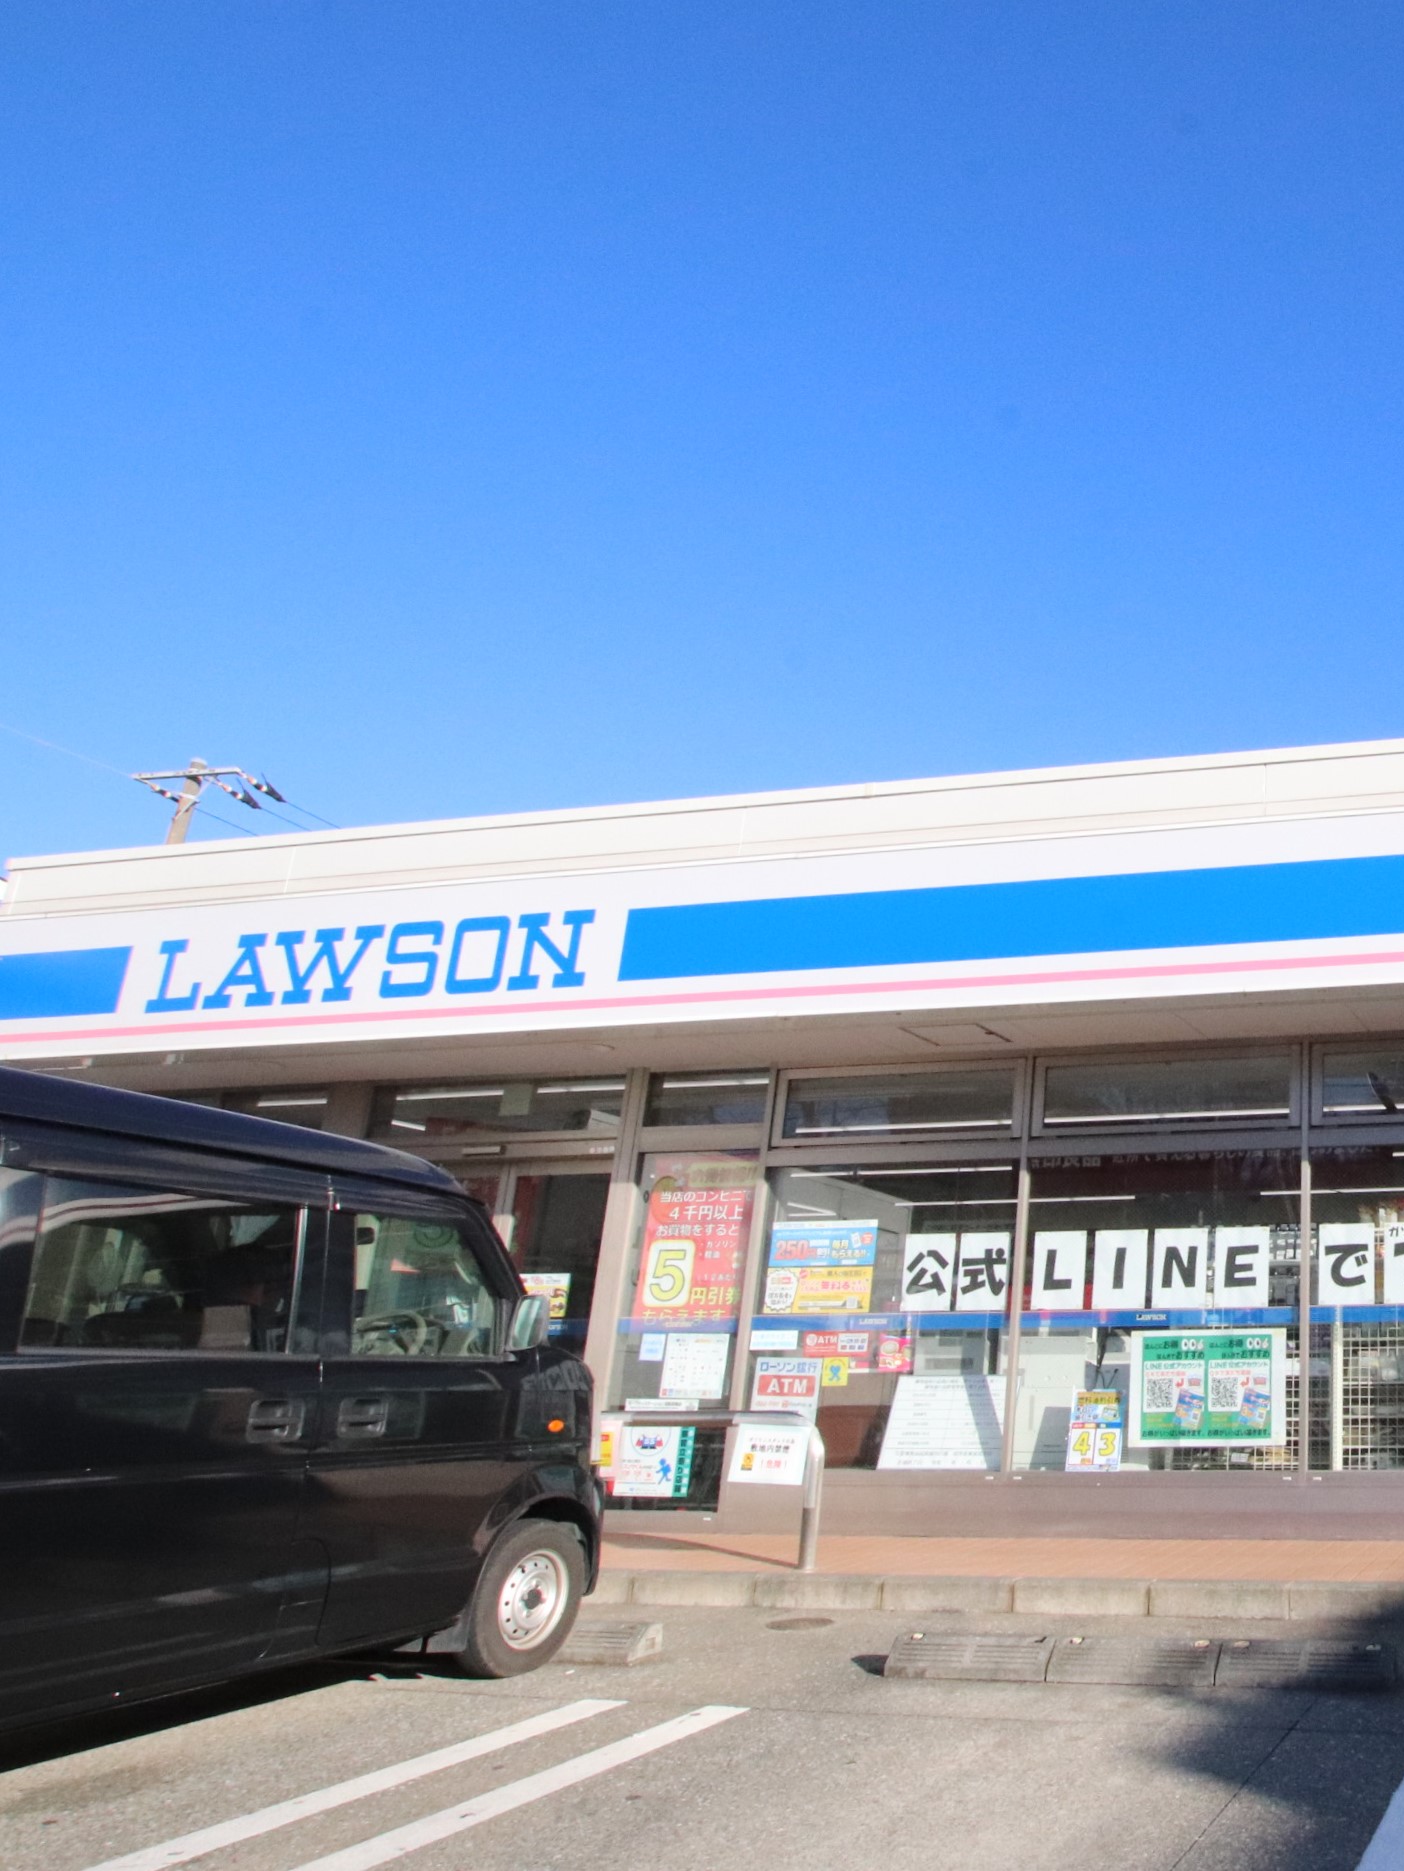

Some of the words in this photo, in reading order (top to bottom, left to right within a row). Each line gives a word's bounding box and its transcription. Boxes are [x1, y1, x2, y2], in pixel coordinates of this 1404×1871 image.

[145, 908, 597, 1013] LAWSON
[817, 1334, 838, 1344] ATM
[766, 1377, 808, 1394] ATM
[1072, 1430, 1091, 1456] 4
[1098, 1431, 1117, 1457] 3
